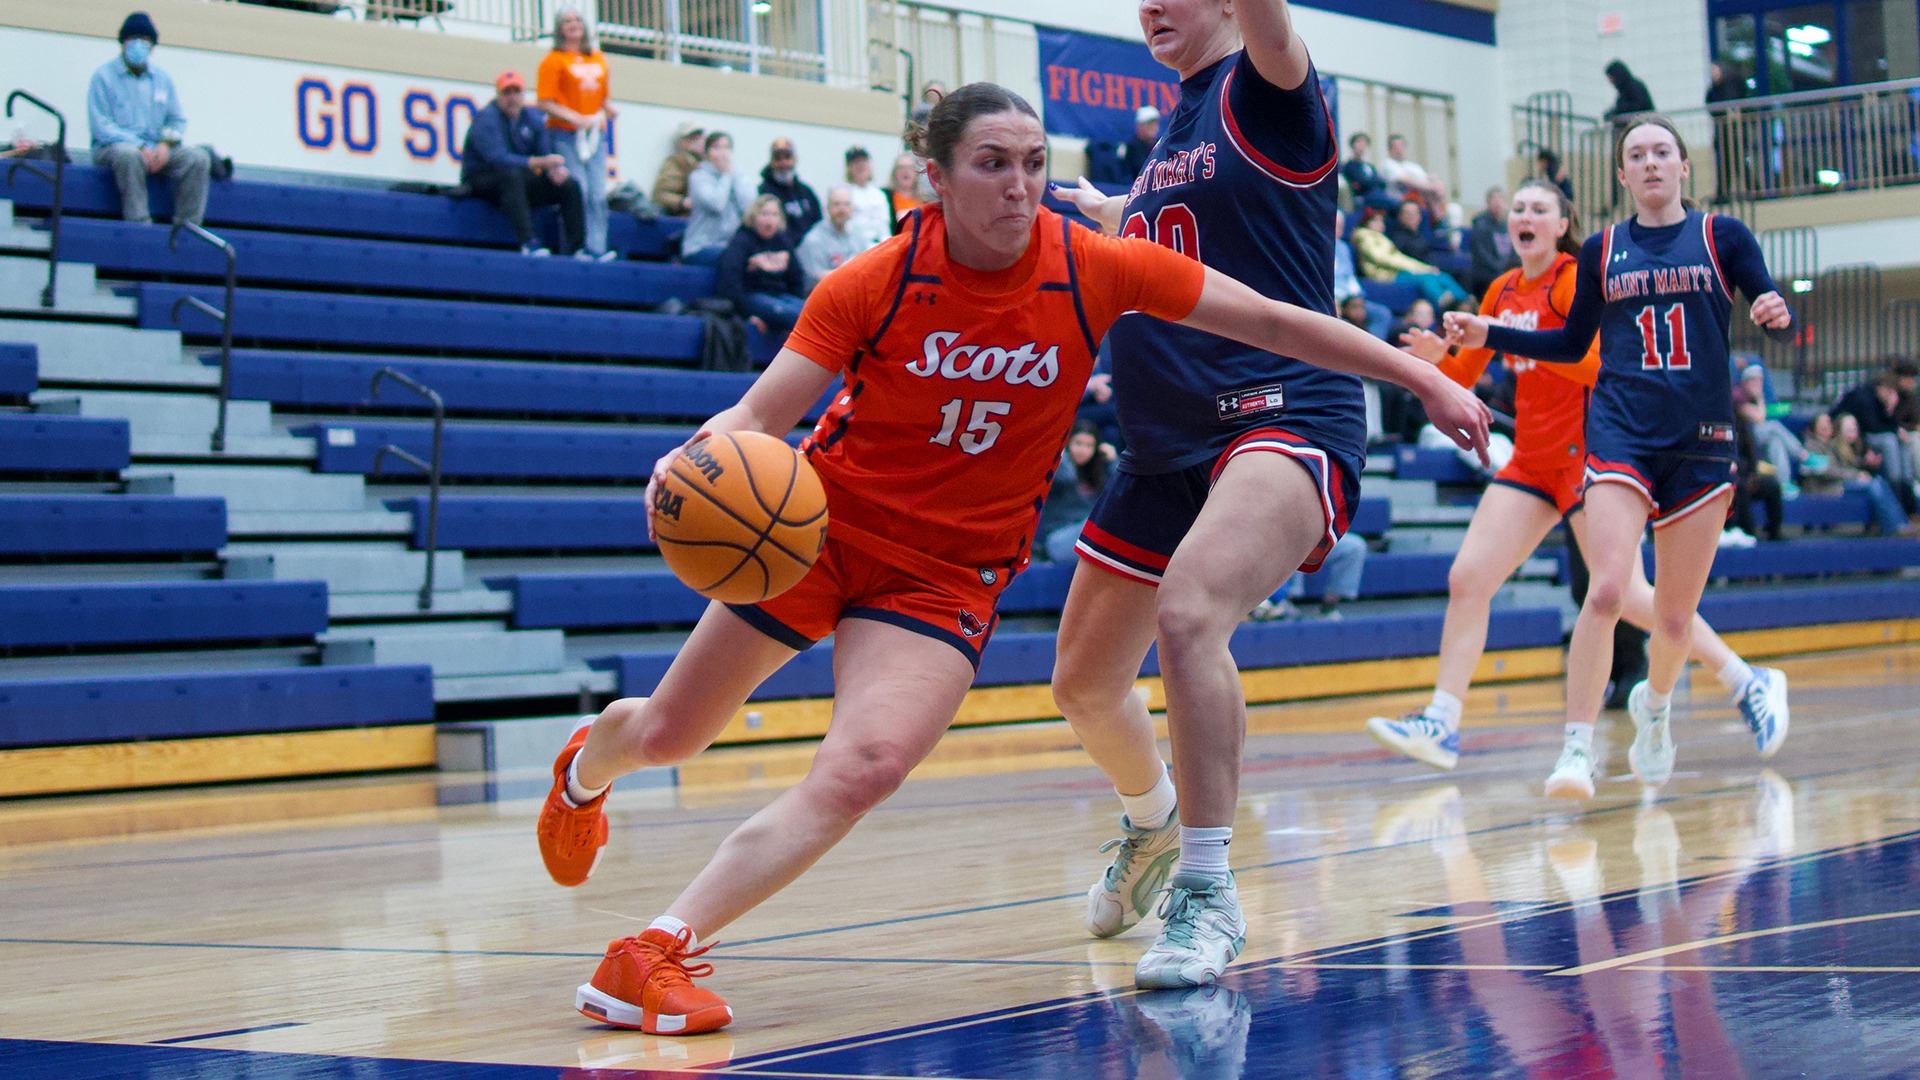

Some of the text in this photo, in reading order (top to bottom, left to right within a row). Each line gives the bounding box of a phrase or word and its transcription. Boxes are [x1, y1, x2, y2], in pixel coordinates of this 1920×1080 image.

[296, 77, 379, 156] GO
[1152, 141, 1216, 193] MARY'S
[1608, 264, 1713, 303] SAINT MARY'S
[904, 330, 1060, 388] Scots
[1636, 302, 1691, 371] 11
[928, 398, 1011, 455] 15
